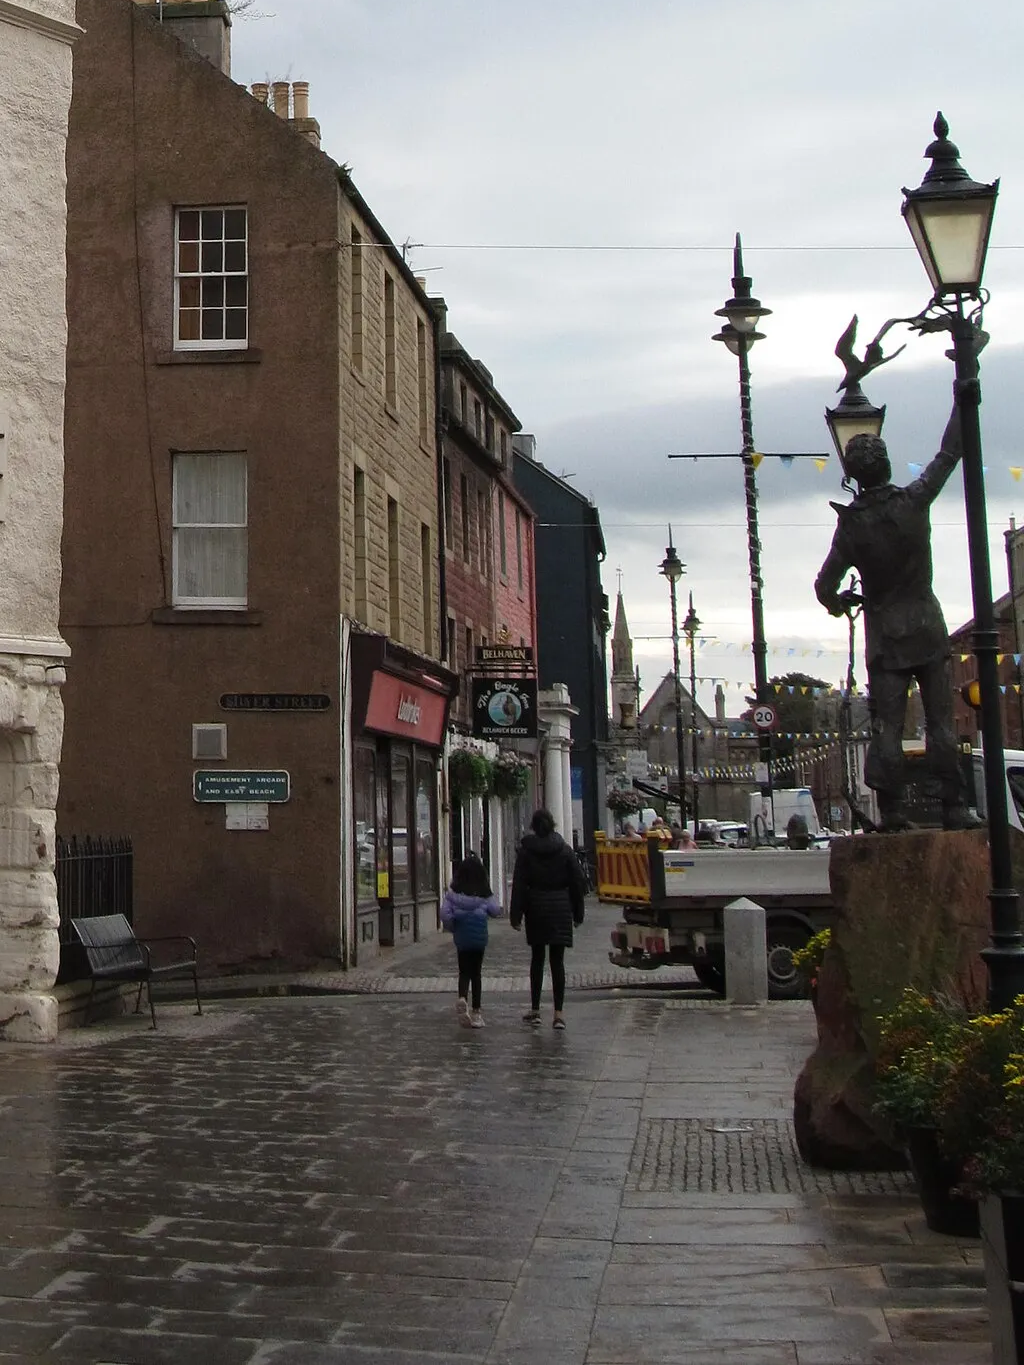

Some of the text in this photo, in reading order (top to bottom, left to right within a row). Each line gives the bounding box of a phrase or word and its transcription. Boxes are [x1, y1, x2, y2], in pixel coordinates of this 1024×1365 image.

[483, 649, 526, 660] BELHAVEN
[226, 695, 324, 708] SILVER STREET
[477, 690, 491, 709] The
[756, 712, 772, 722] 20
